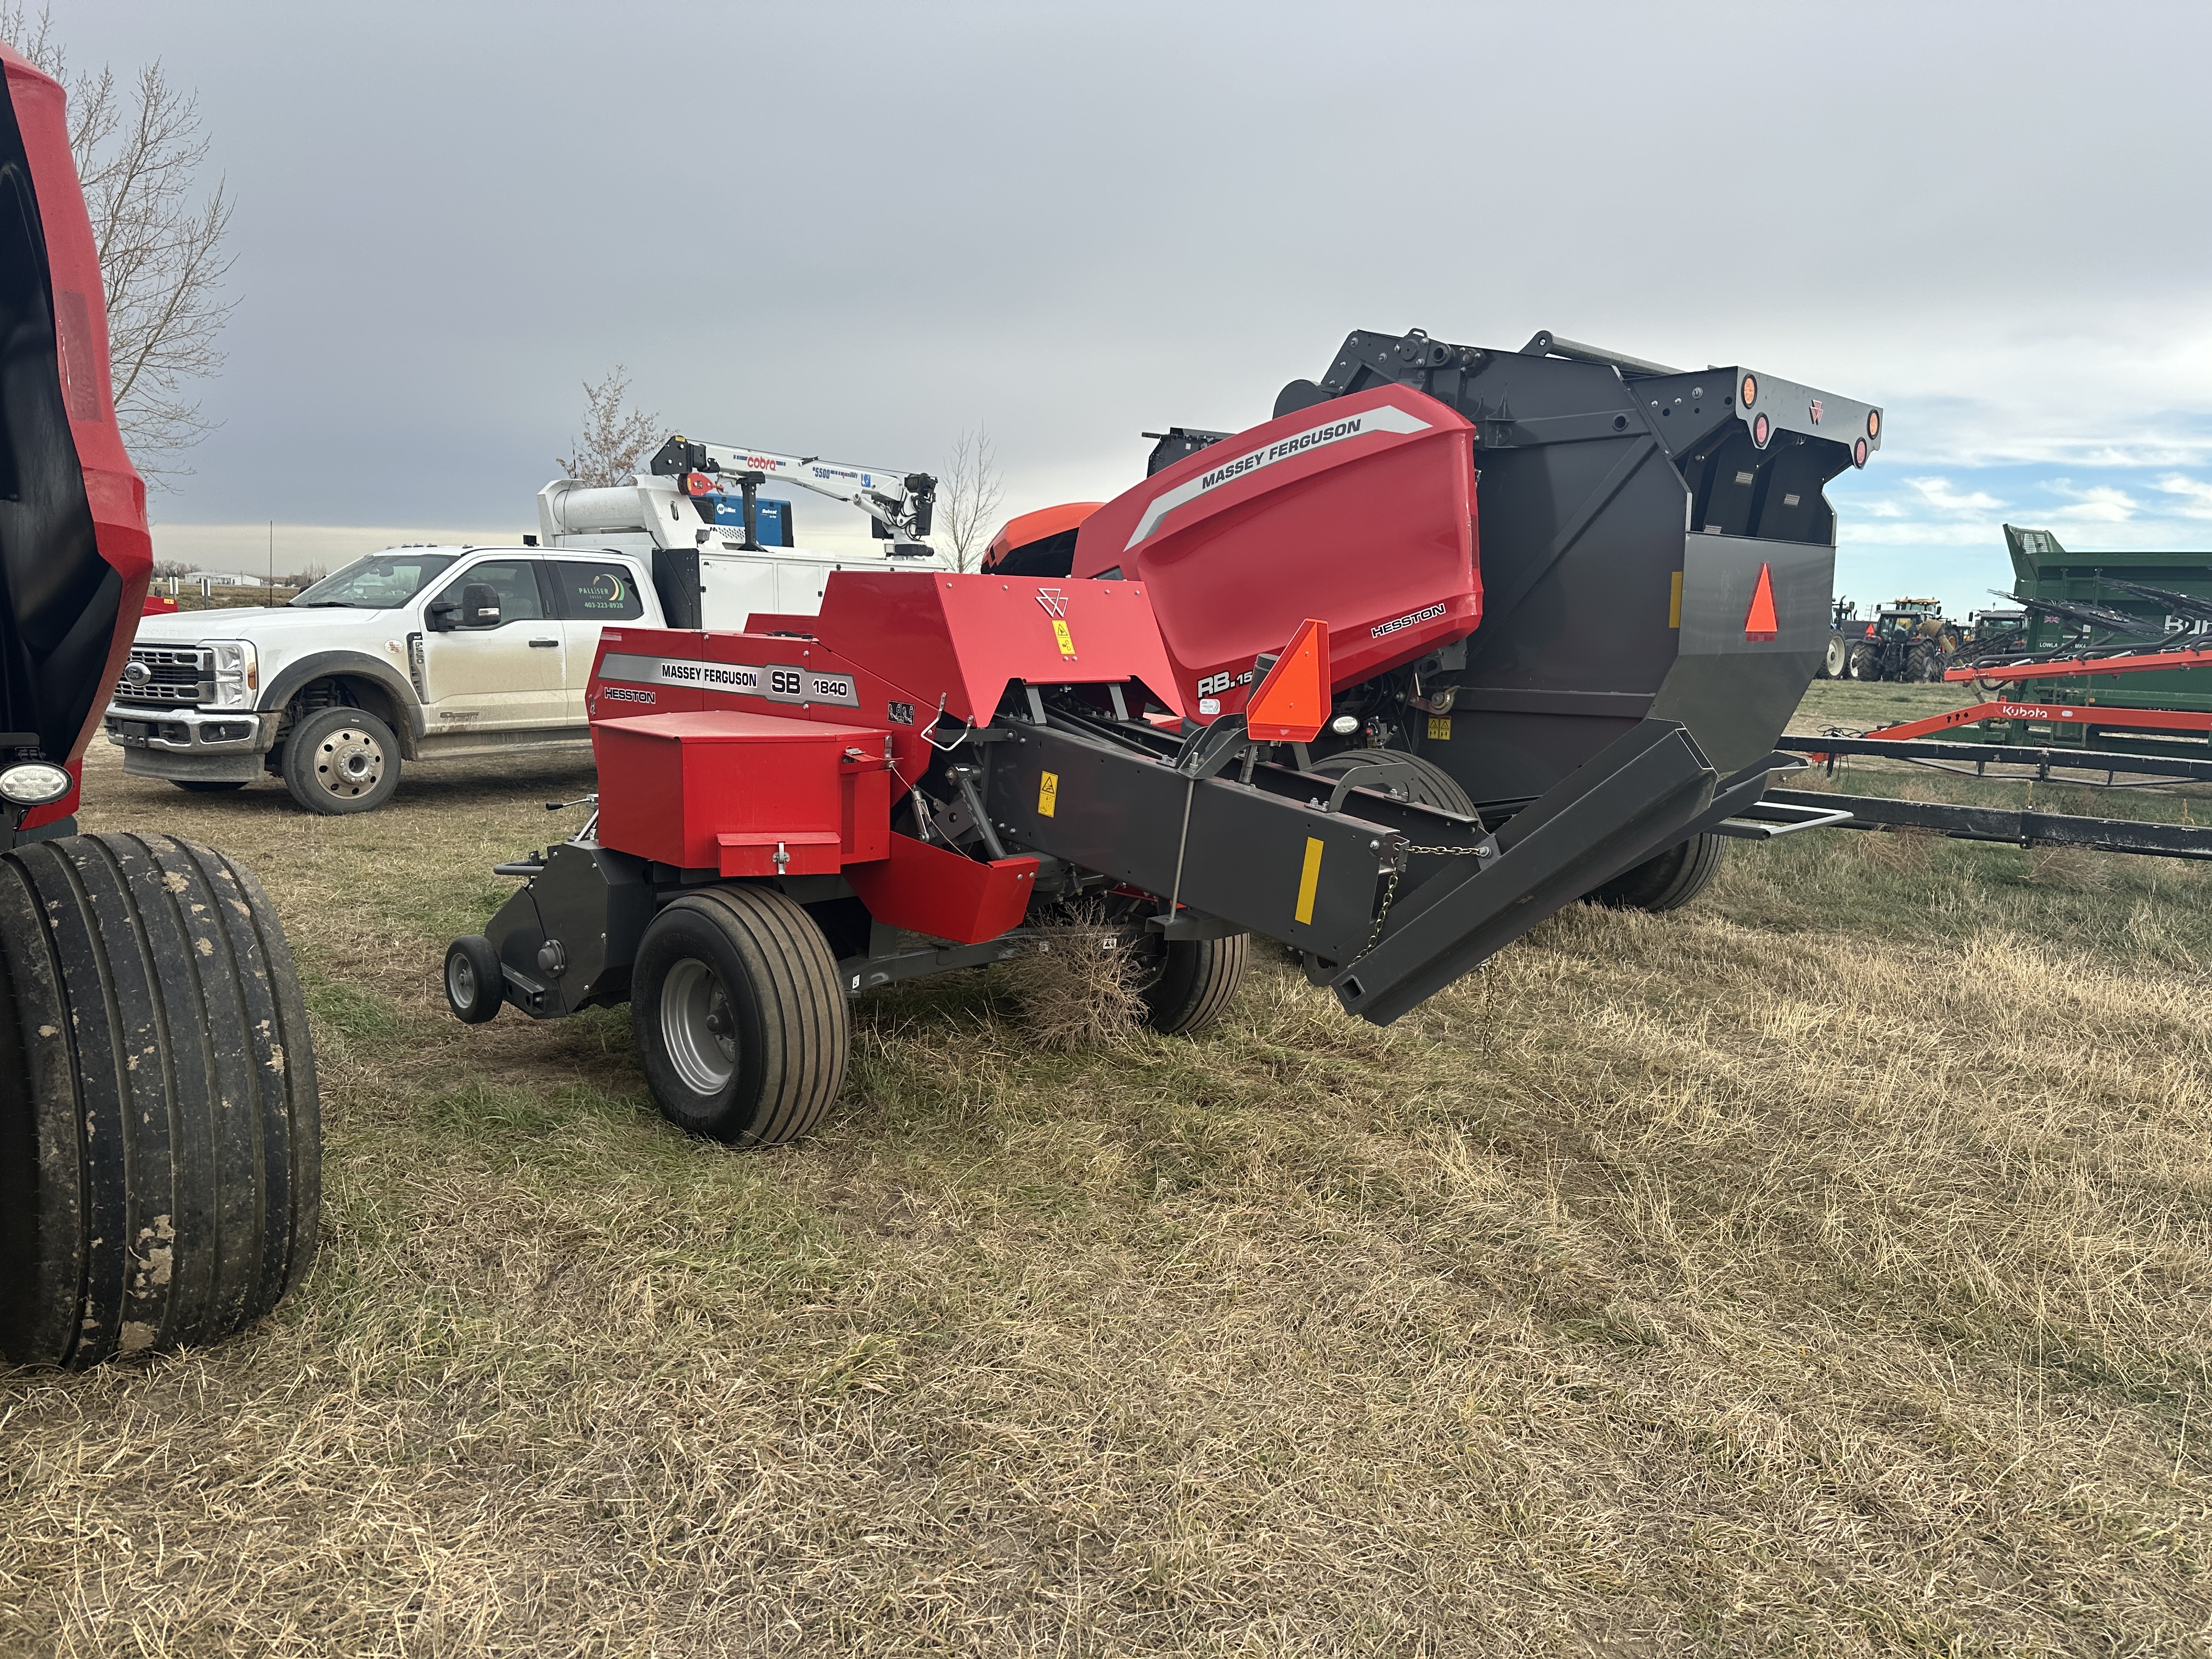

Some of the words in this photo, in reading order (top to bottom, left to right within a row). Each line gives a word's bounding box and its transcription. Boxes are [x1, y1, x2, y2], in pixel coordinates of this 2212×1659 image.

[1202, 452, 1265, 489] MASSEY
[1269, 419, 1361, 460] FERGUSON
[815, 467, 830, 479] 5500
[578, 586, 609, 595] PALLISER
[1371, 603, 1446, 639] HESSTON
[662, 663, 701, 681] MASSEY
[704, 667, 758, 688] FERGUSON
[771, 670, 801, 696] SB
[812, 679, 848, 697] 1840
[605, 687, 656, 704] HESSTON
[2002, 706, 2047, 719] Kubota
